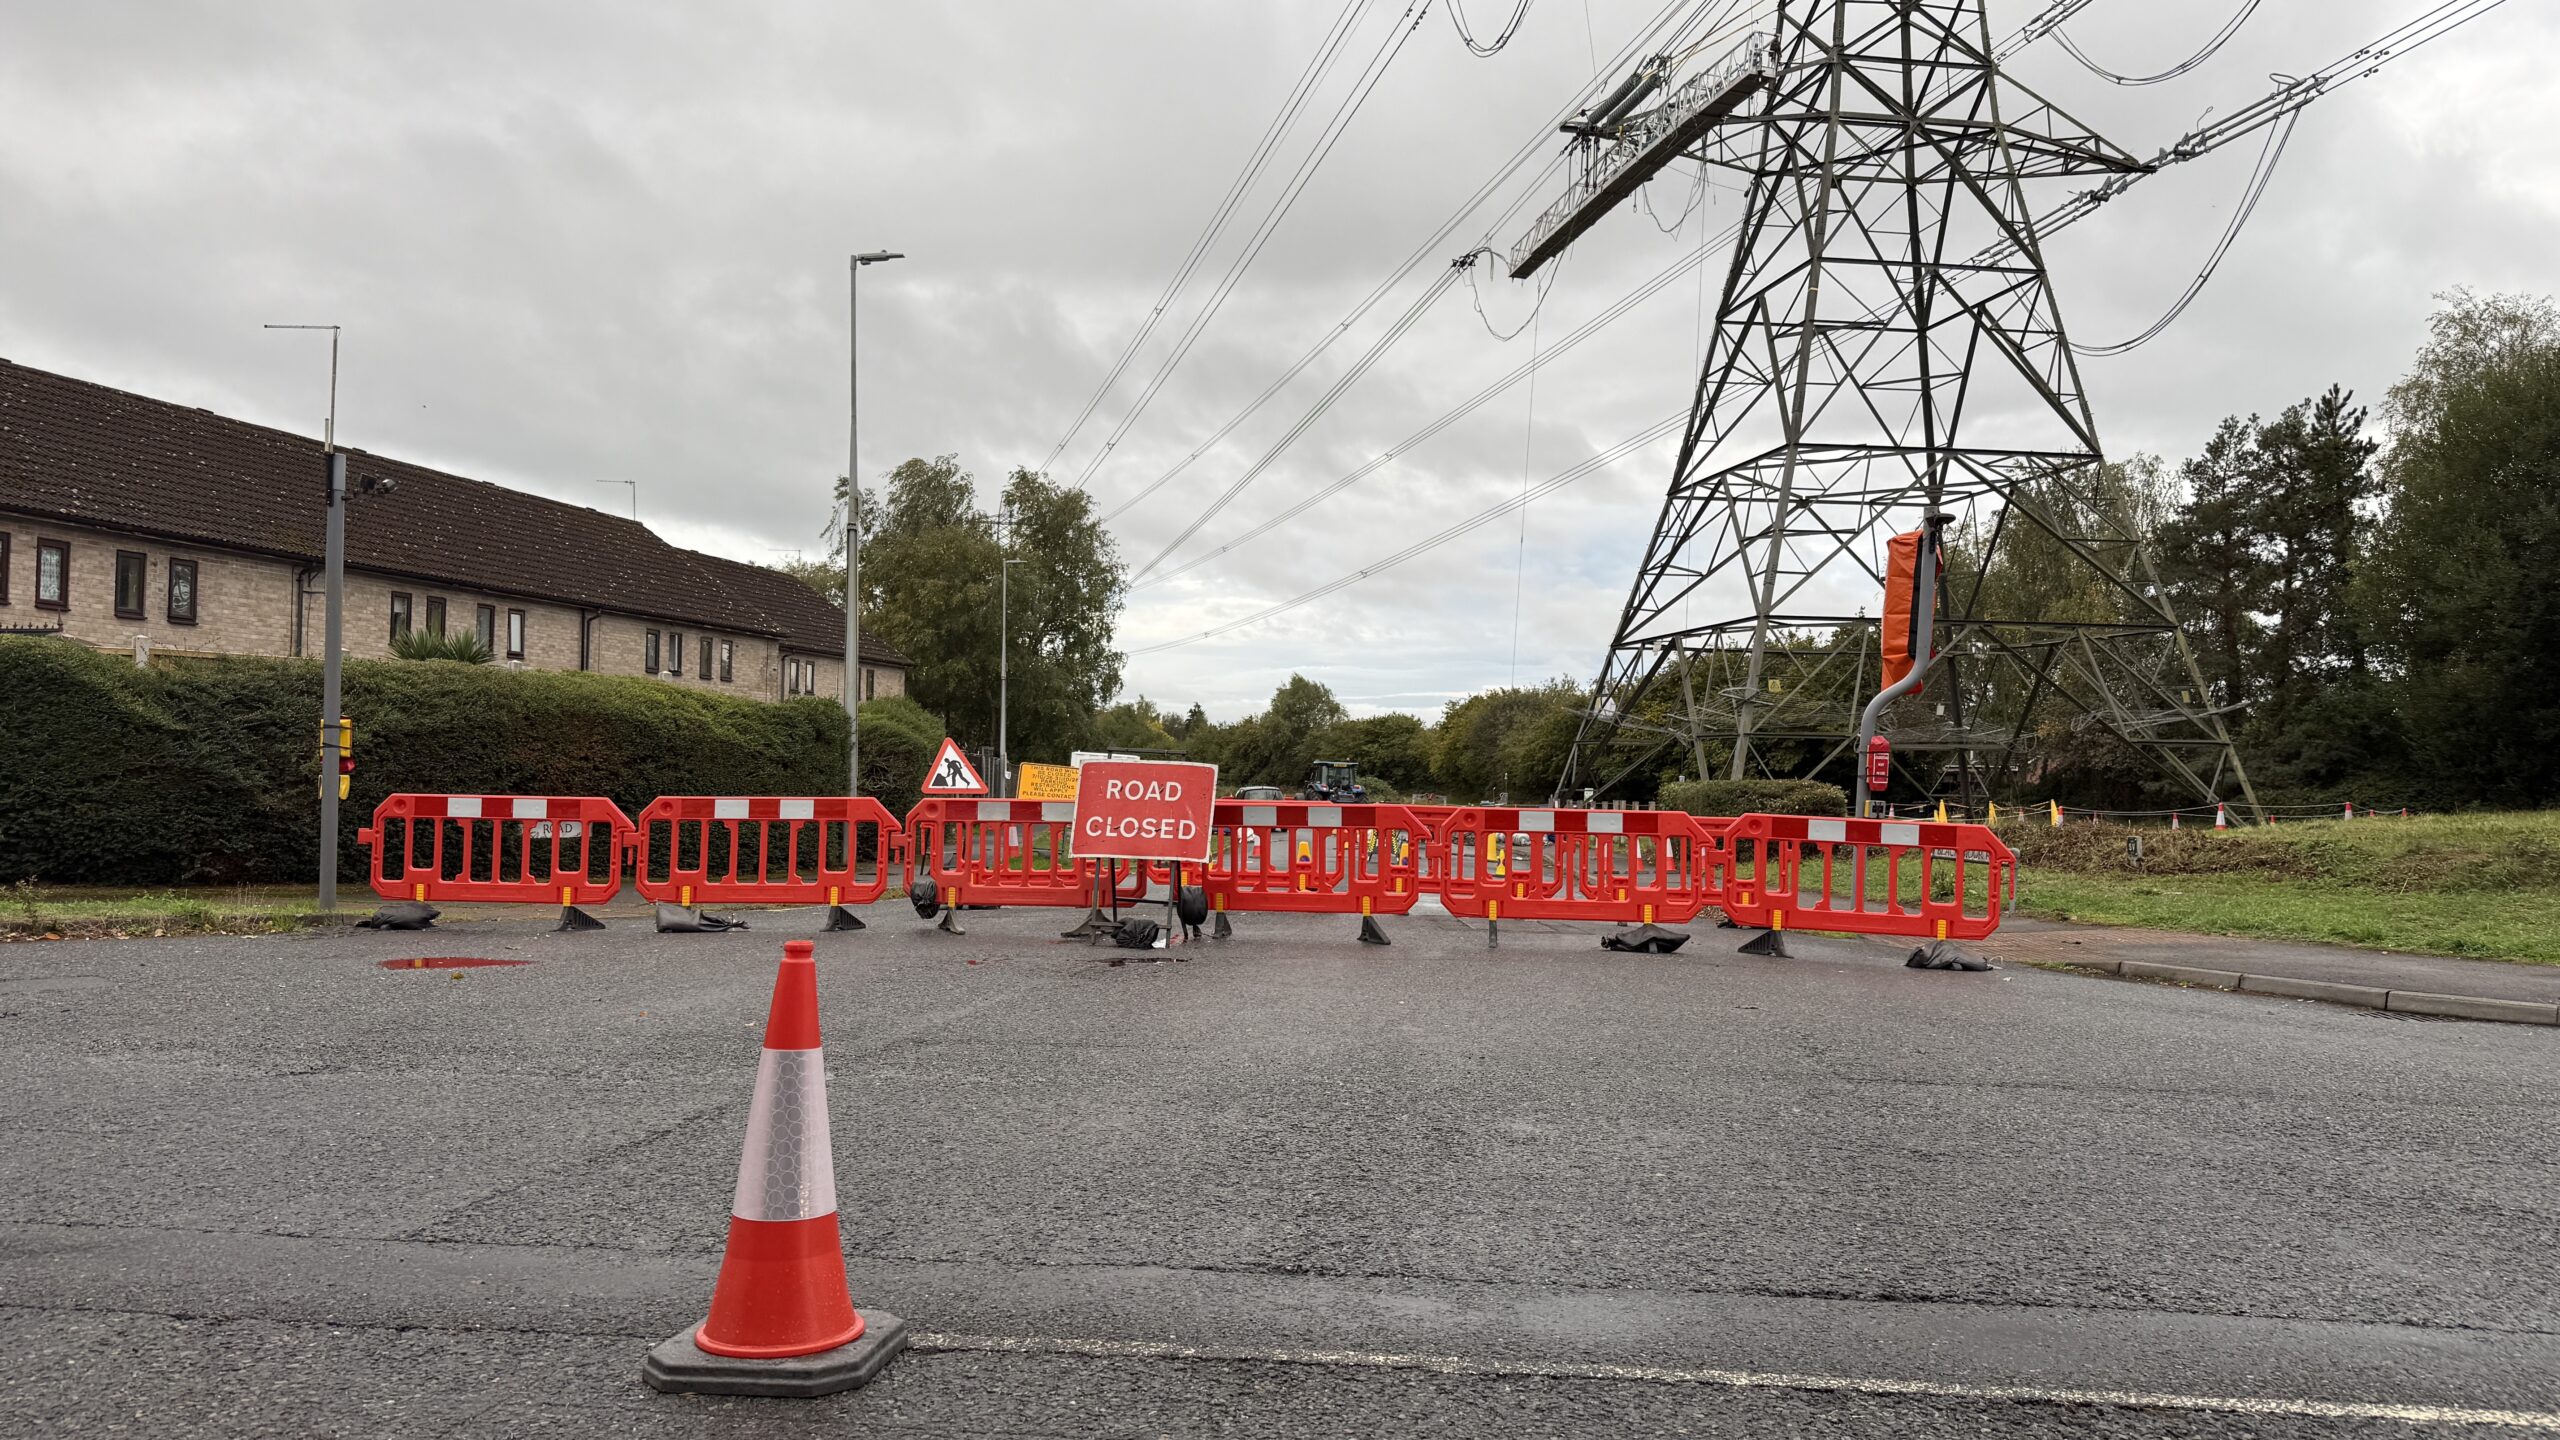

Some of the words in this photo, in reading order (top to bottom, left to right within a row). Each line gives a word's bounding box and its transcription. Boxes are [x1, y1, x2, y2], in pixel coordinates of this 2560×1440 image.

[1031, 782, 1075, 790] RESTRICTIONS
[1106, 780, 1182, 801] ROAD
[543, 823, 573, 834] RD
[1085, 816, 1196, 840] CLOSED
